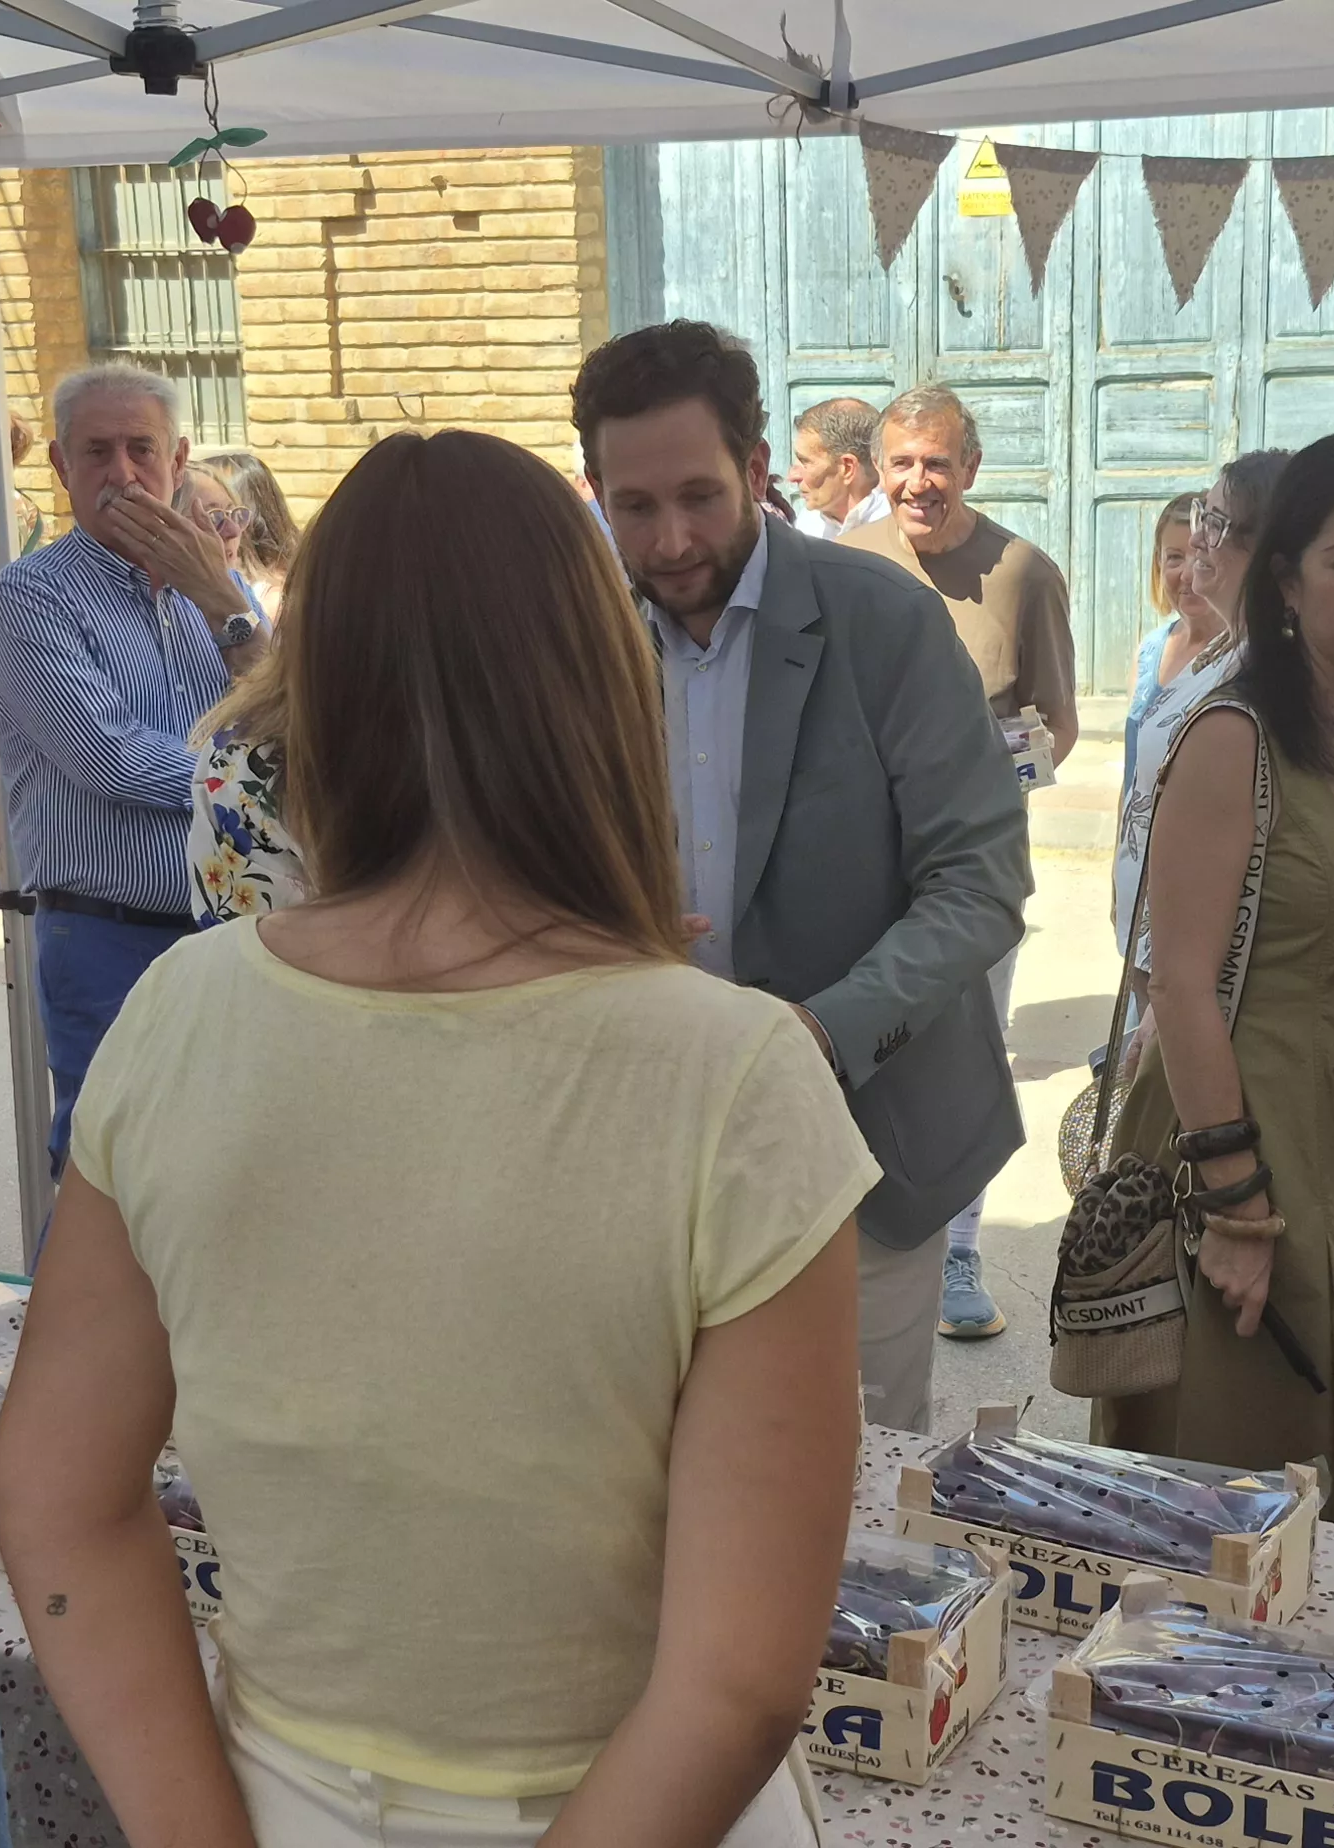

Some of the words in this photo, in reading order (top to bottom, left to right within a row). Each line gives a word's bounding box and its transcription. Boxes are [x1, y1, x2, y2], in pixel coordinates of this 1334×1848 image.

[1067, 1296, 1146, 1323] CSDMNT
[964, 1532, 1111, 1577] CEREZAS
[808, 1742, 882, 1768] (HUESCA)
[1131, 1748, 1315, 1801] CEREZAS
[1134, 1820, 1161, 1833] 638
[1167, 1827, 1192, 1841] 114
[1196, 1834, 1224, 1848] 438
